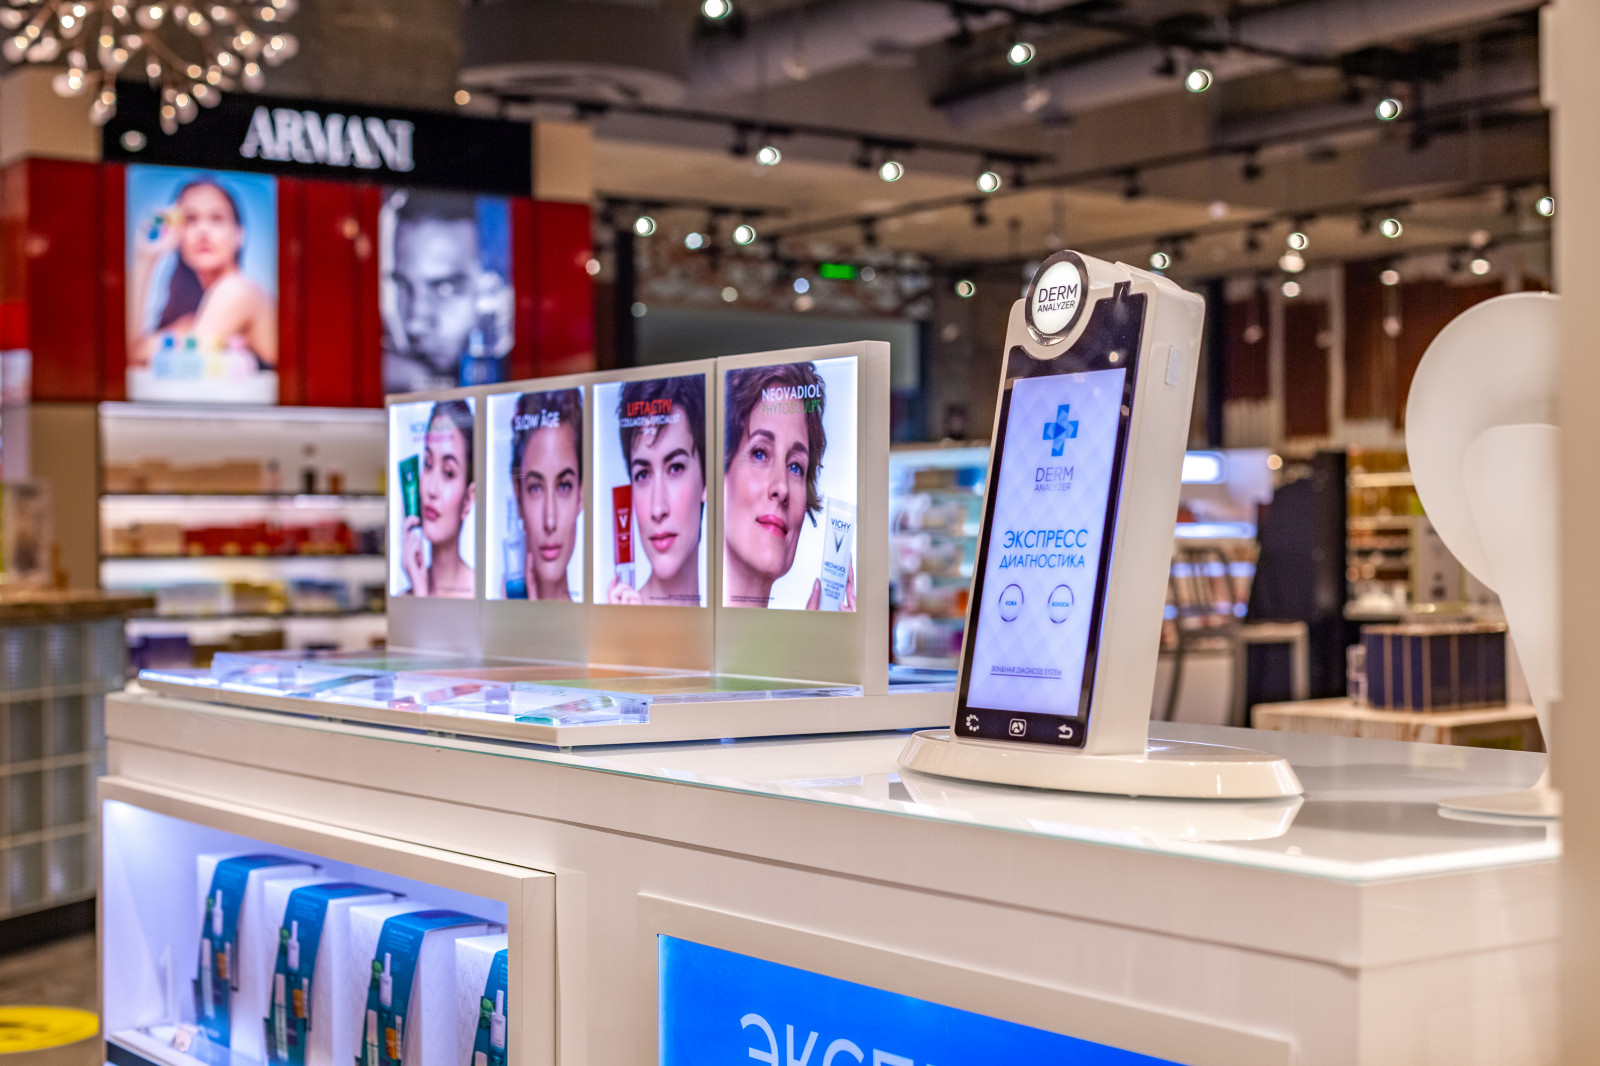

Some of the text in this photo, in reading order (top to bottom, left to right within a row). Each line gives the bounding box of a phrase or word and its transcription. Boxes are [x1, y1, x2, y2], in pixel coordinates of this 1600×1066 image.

[239, 105, 416, 172] ARMANI
[1038, 283, 1078, 303] DERM
[1037, 300, 1076, 313] ANALYZER
[761, 384, 821, 402] NEOVADIOL
[627, 399, 673, 417] LIFTACTIV
[761, 399, 821, 416] PHYTOSCULPT
[514, 413, 540, 431] SLOW
[1035, 466, 1075, 482] DERM
[1034, 482, 1072, 492] ANALYZER
[831, 517, 852, 531] VICHY
[1003, 529, 1089, 549] ЭКСПРЕСС
[999, 553, 1086, 569] ДИАГНОСТИКА
[1044, 668, 1062, 676] SYSTEM
